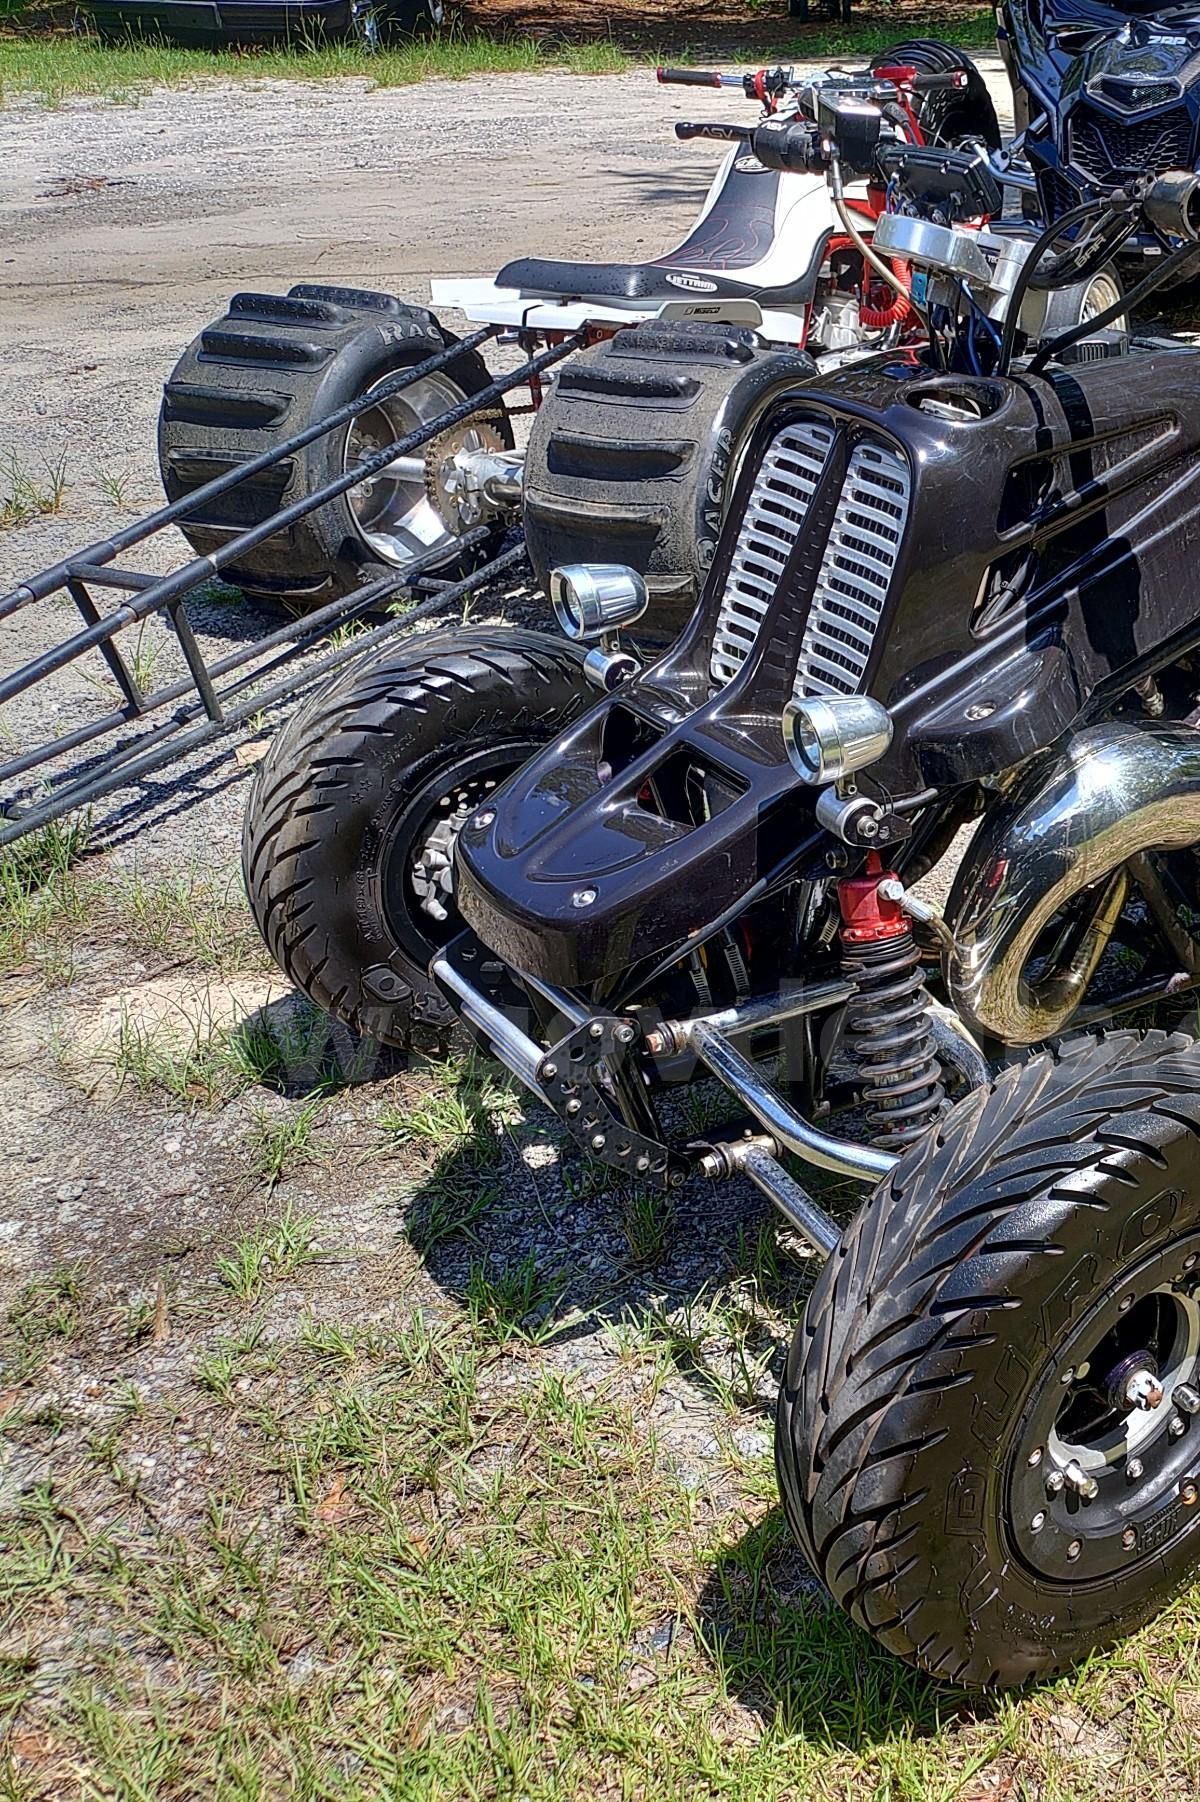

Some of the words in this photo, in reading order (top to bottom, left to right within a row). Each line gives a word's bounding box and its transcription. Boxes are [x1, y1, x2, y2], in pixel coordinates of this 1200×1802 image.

[700, 126, 733, 139] ASV
[1075, 235, 1107, 268] BAR
[376, 320, 442, 346] RAC
